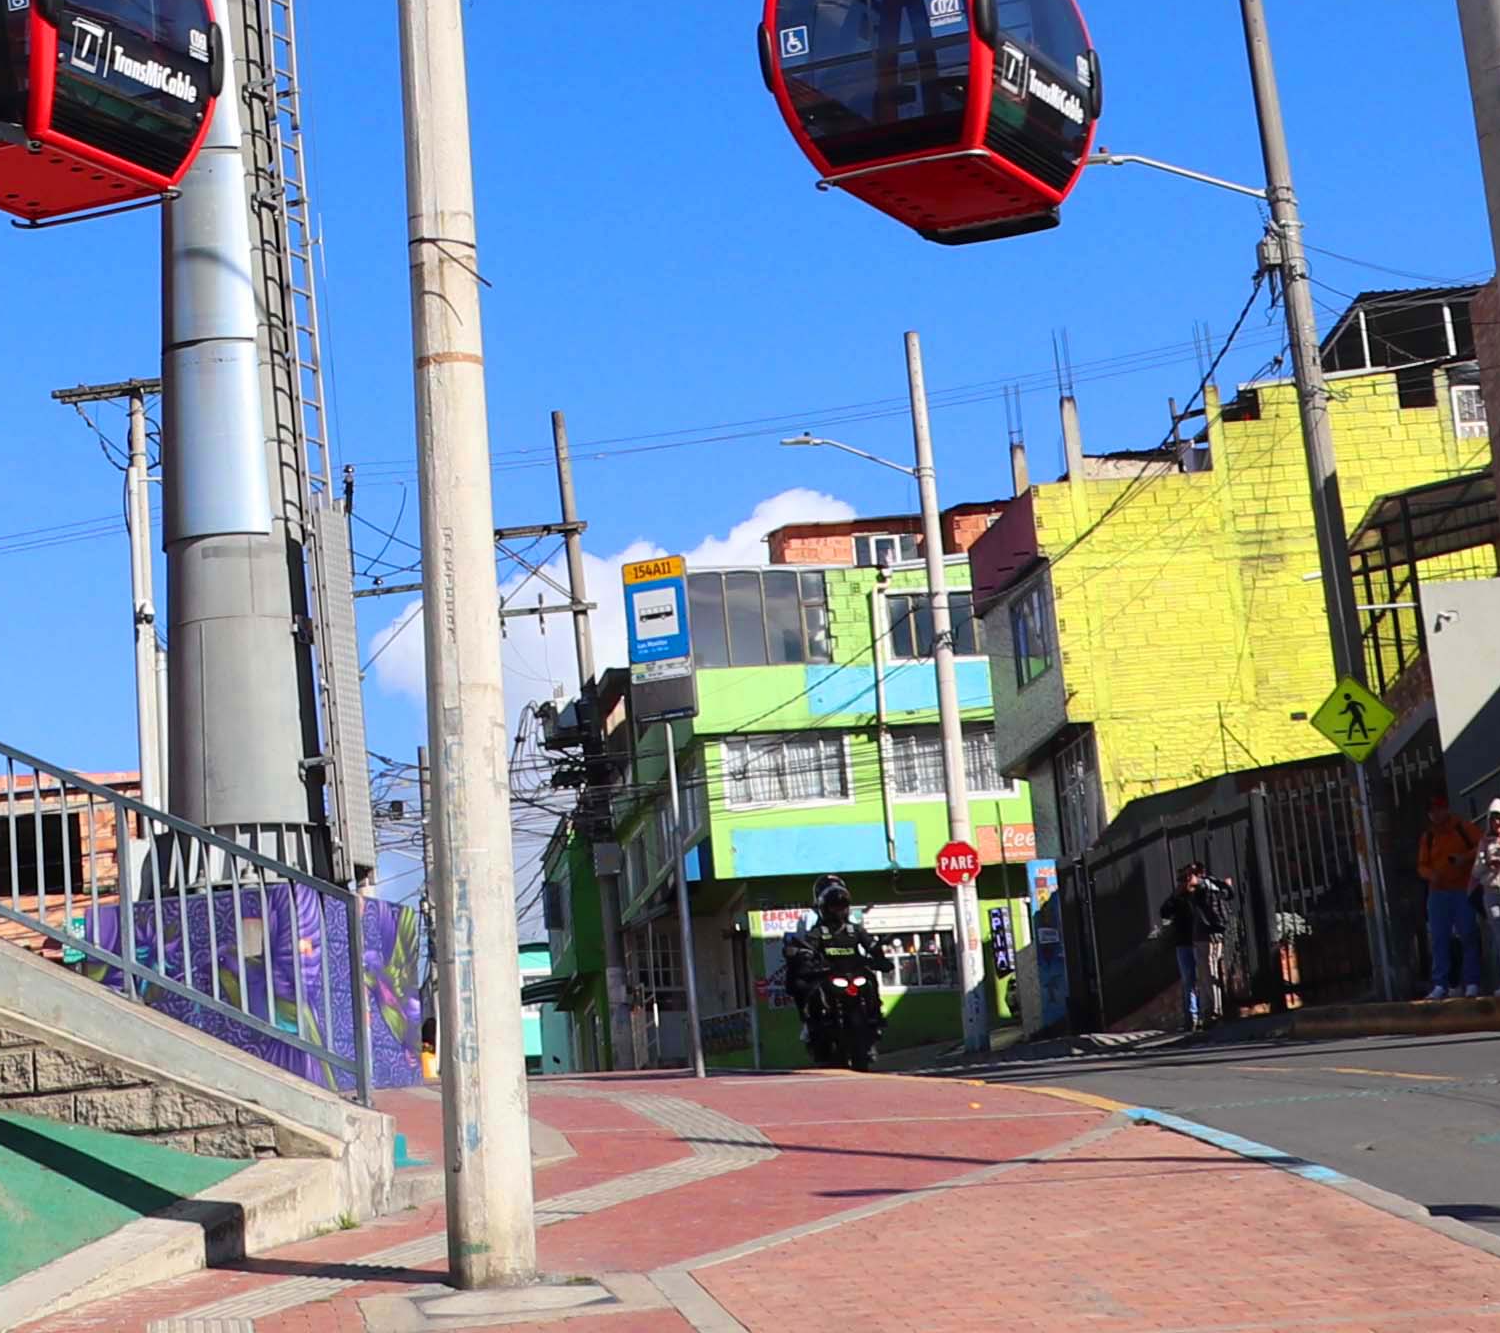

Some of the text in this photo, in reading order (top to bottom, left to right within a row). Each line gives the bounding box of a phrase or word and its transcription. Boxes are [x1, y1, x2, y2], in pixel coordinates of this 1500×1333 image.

[113, 45, 198, 103] TransMiCable
[1029, 68, 1084, 125] TransMiCable
[940, 855, 975, 871] PARE
